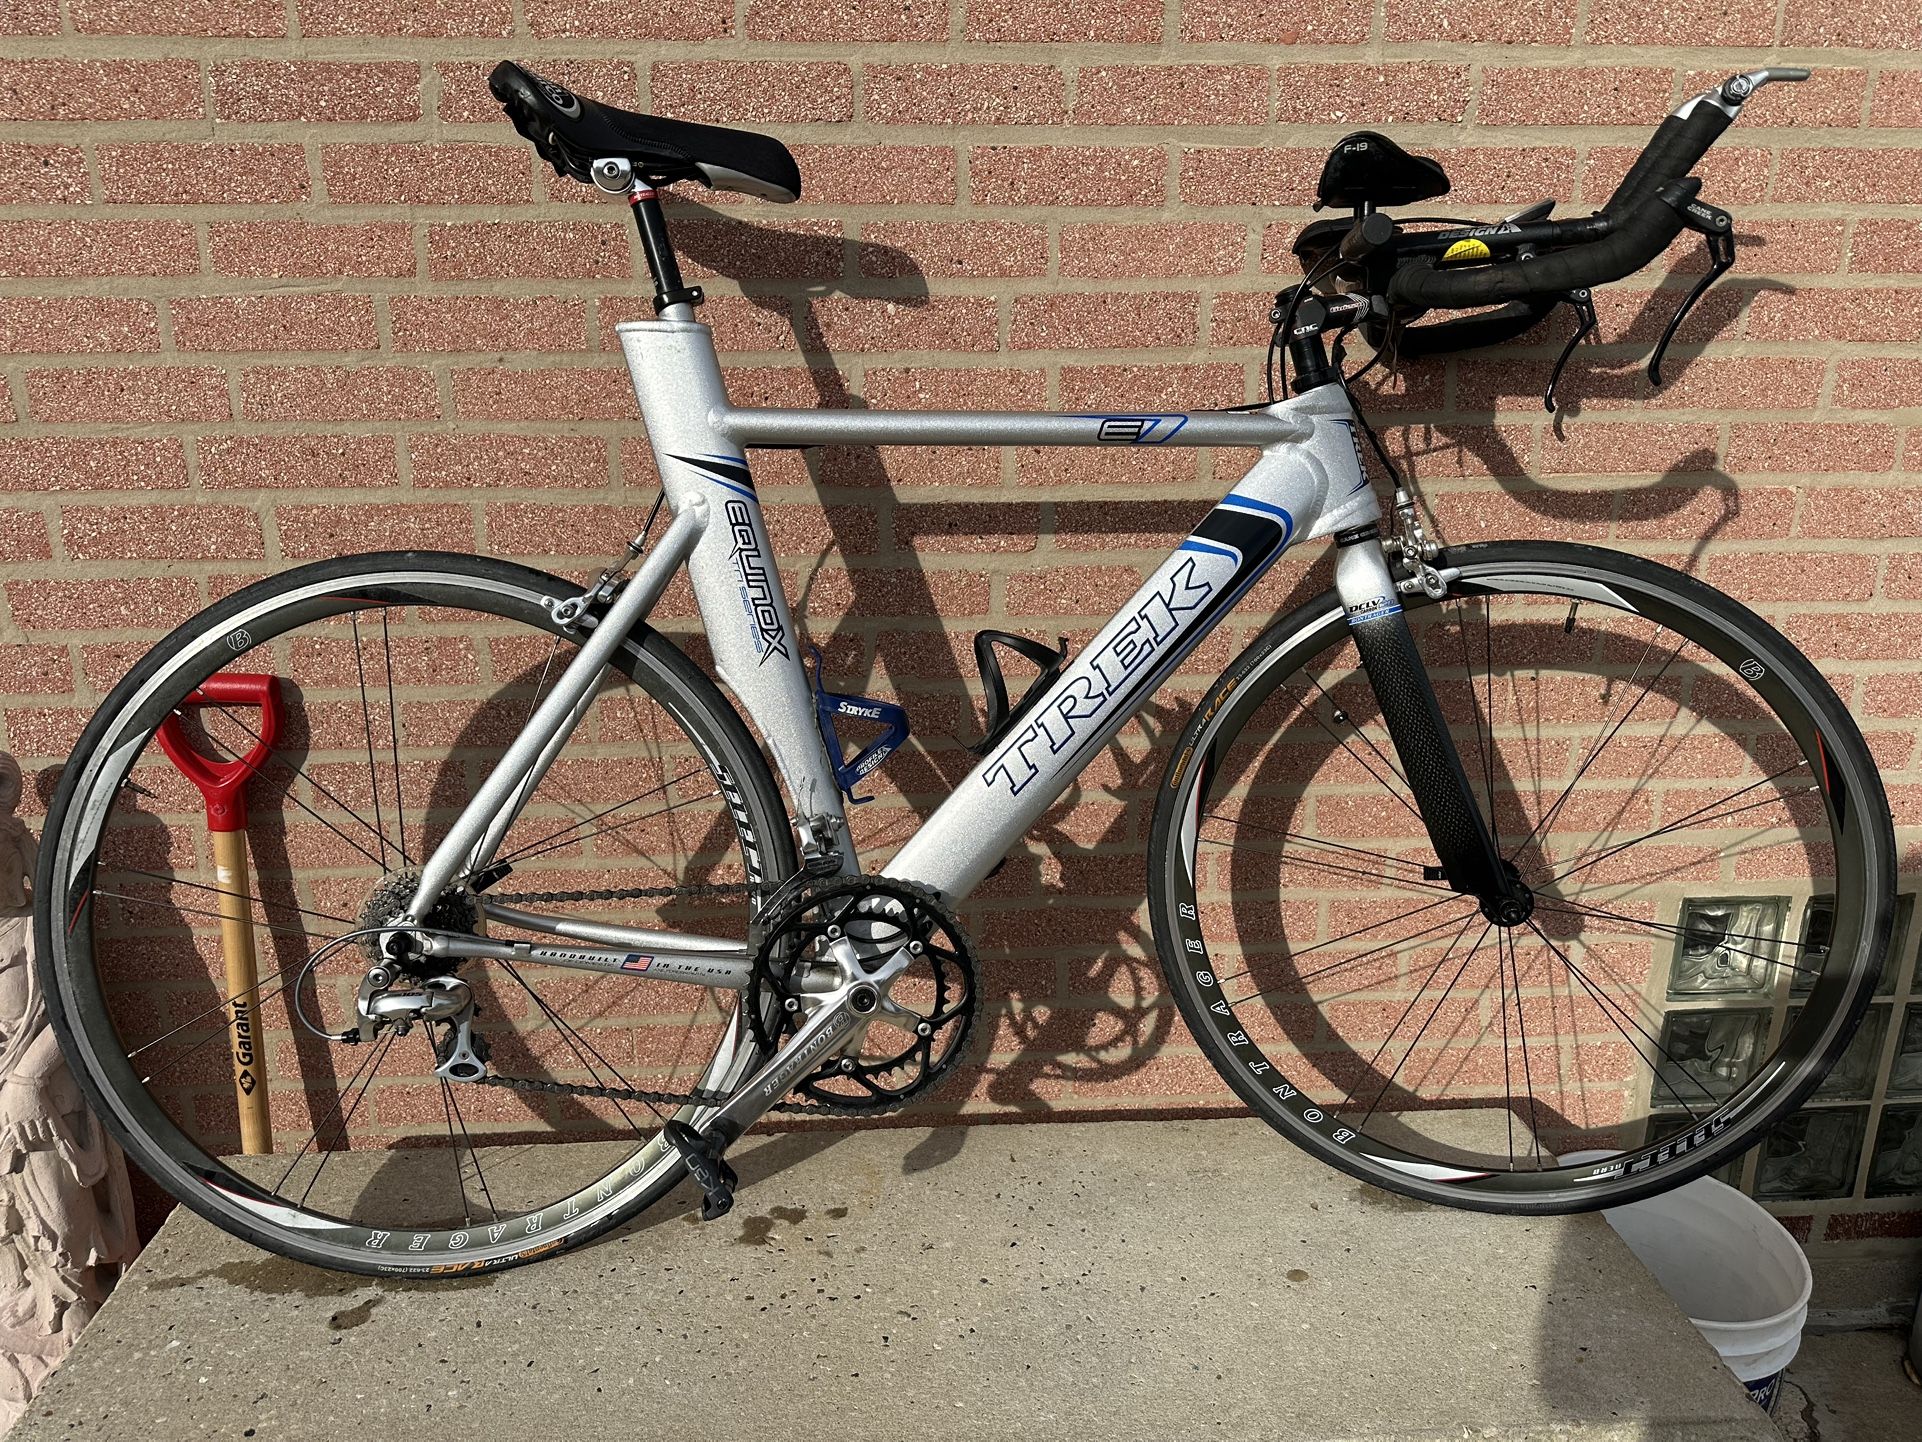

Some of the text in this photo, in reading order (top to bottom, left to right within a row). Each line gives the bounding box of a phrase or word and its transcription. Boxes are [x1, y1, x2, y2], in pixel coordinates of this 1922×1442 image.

[1344, 142, 1368, 154] F-19
[1438, 226, 1498, 240] DESIGN
[1349, 424, 1369, 481] TREK
[724, 500, 791, 667] EQUINOX
[982, 557, 1213, 797] TREK
[838, 702, 882, 719] STRYKE
[1189, 717, 1207, 746] ULTRA
[1203, 677, 1237, 722] RACE
[539, 950, 618, 963] HANDBUILT
[677, 964, 701, 972] THE
[707, 967, 733, 975] USA
[232, 1000, 254, 1067] Garant
[1179, 902, 1356, 1145] BONTRAGER
[763, 1026, 834, 1096] BONTRAGER
[430, 1259, 486, 1274] RACE
[485, 1254, 519, 1267] ULTRA
